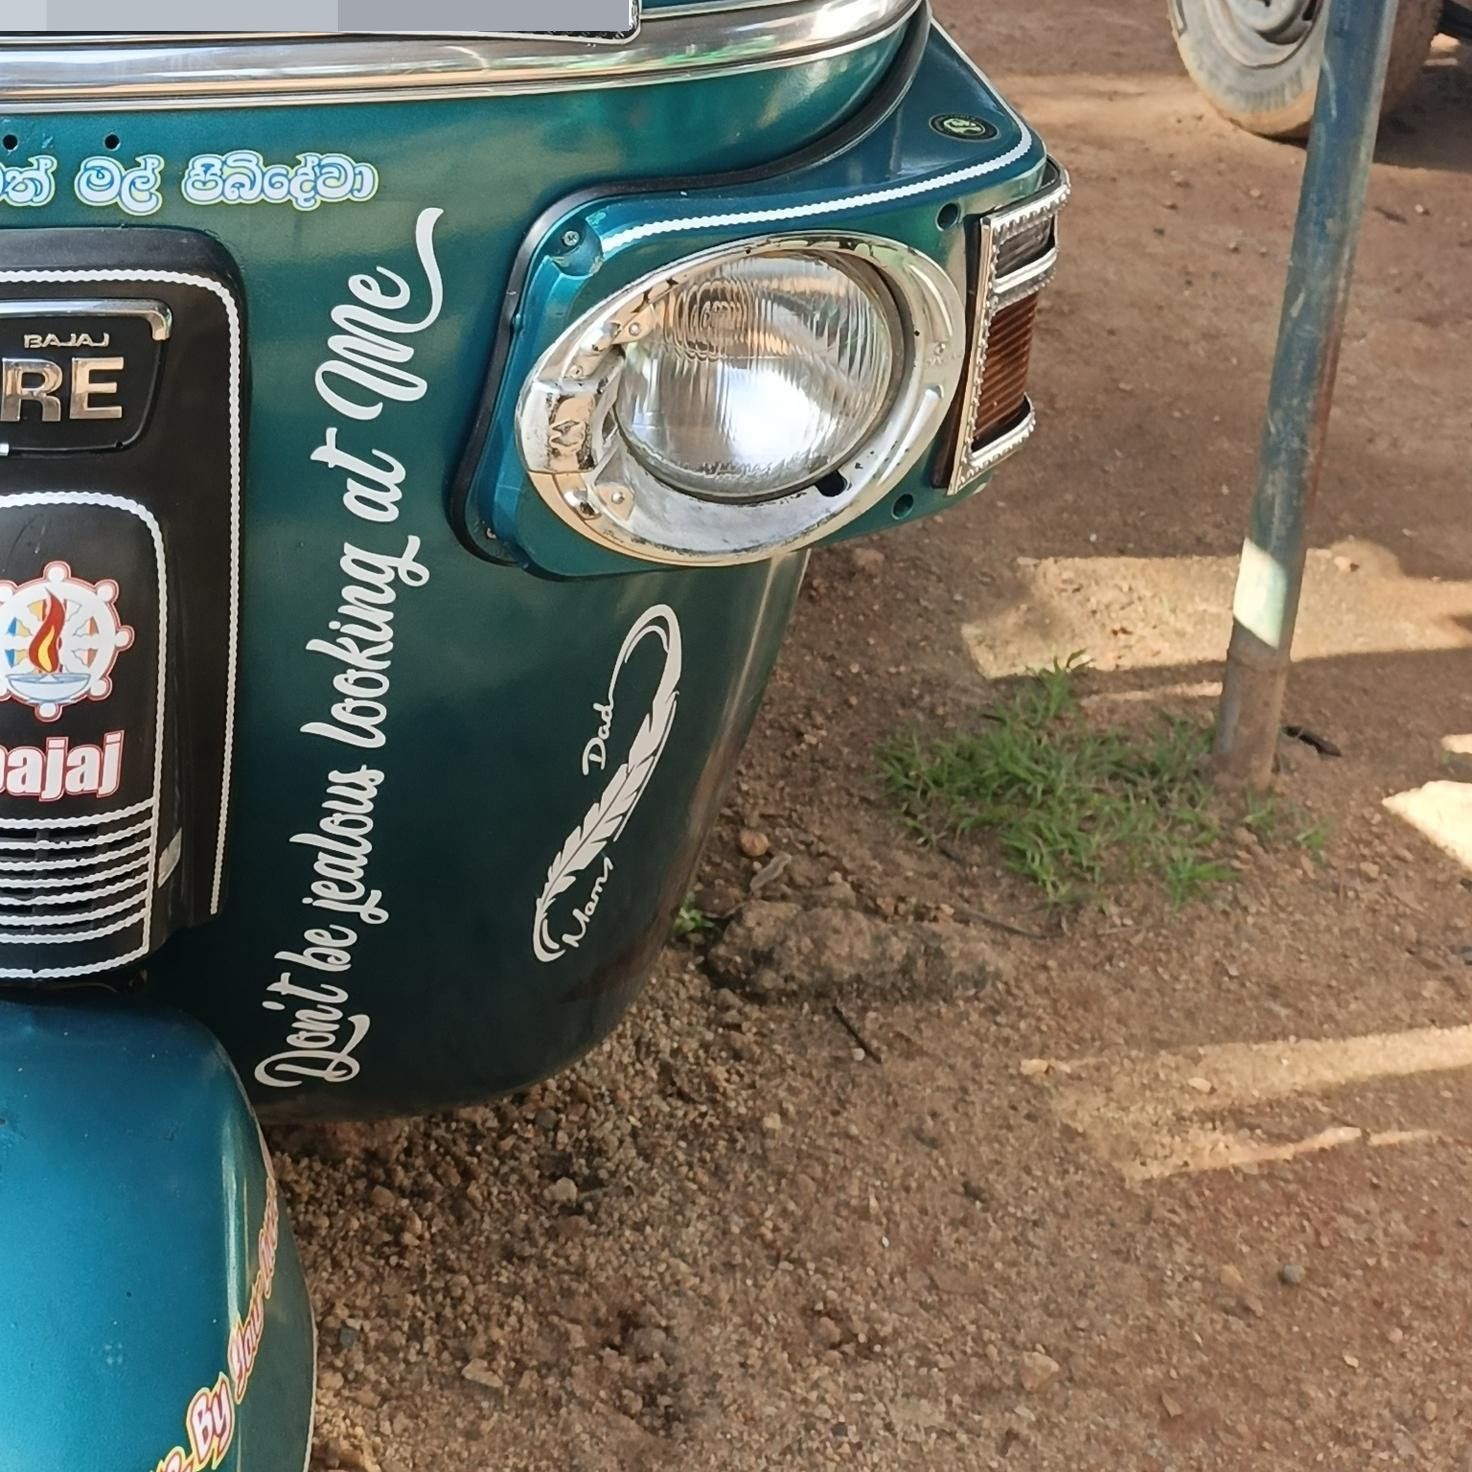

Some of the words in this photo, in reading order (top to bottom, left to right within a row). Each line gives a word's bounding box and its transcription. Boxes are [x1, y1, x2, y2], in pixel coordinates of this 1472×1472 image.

[74, 154, 163, 216] මල්
[24, 333, 110, 349] BAJAJ
[315, 207, 444, 420] Me
[0, 356, 125, 422] RE
[310, 427, 406, 522] at
[300, 535, 430, 748] looking
[582, 700, 615, 776] Dad
[289, 764, 389, 924] jealous
[274, 924, 357, 972] be
[254, 972, 370, 1088] Don't
[186, 1371, 235, 1469] By
